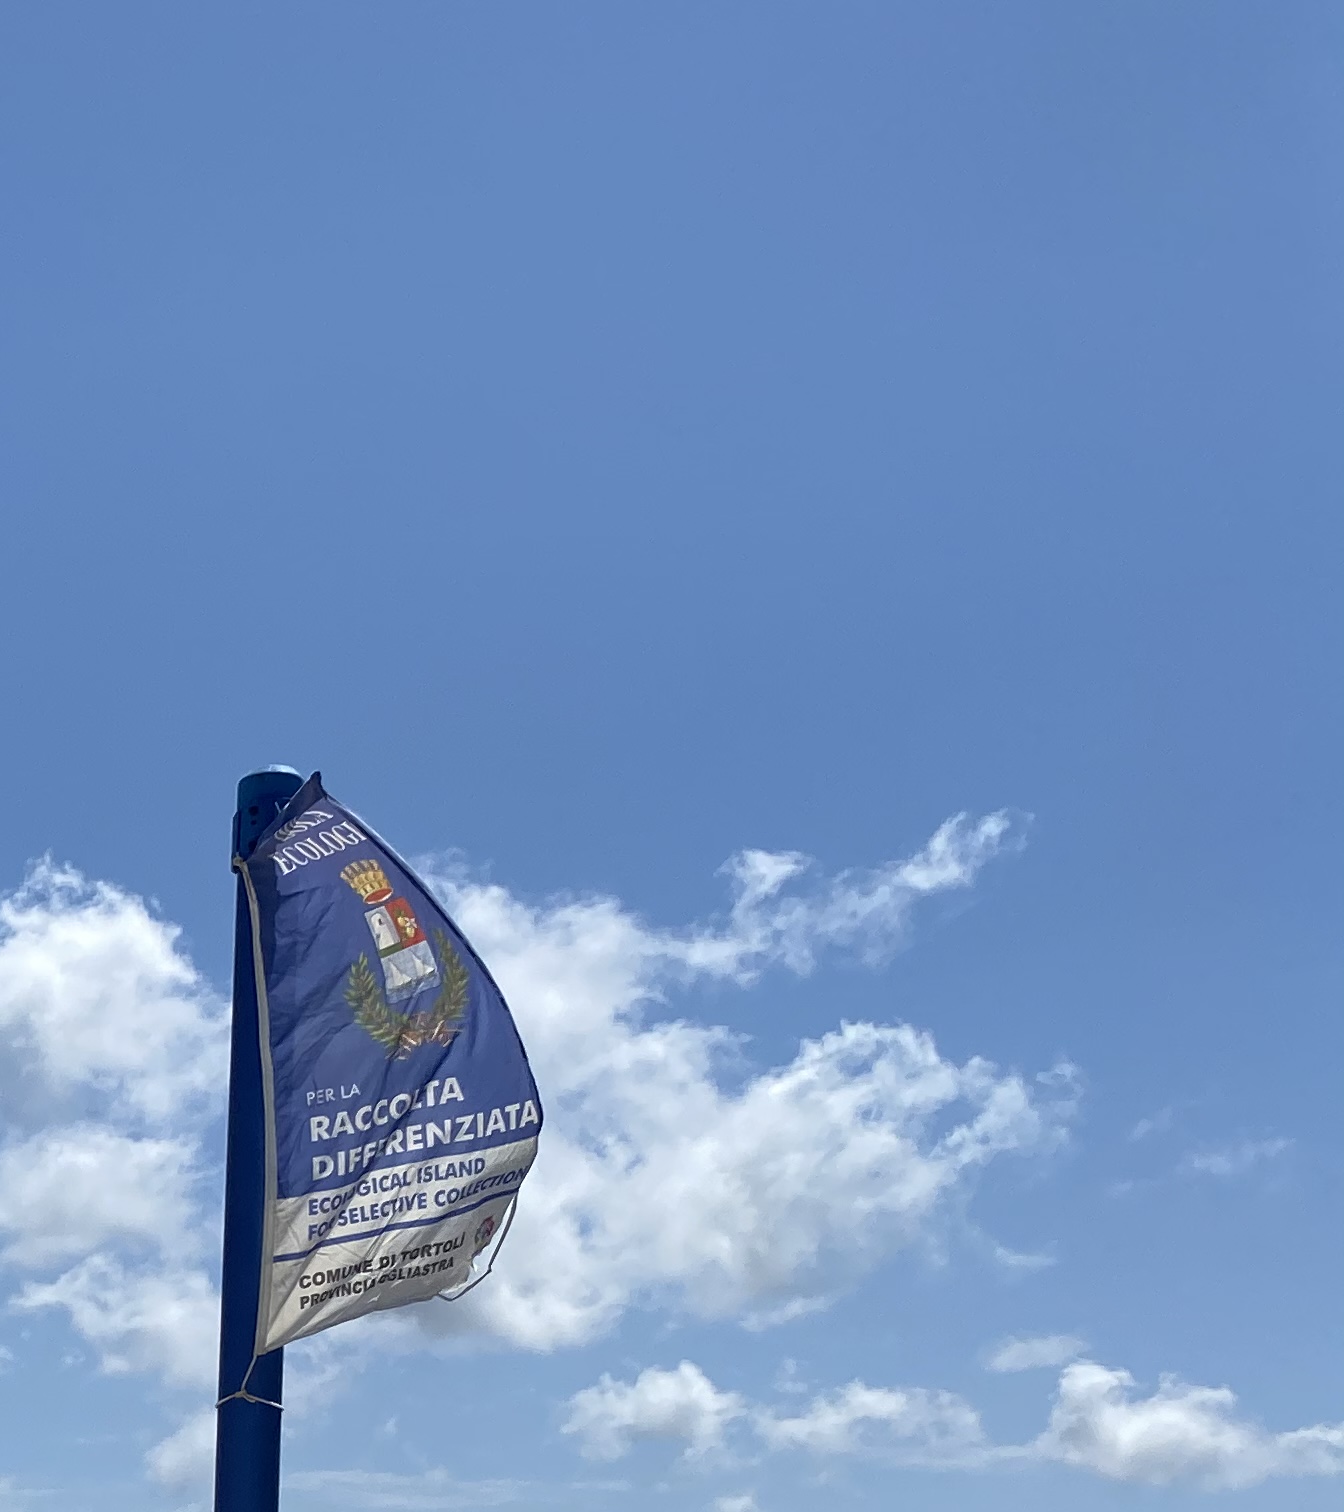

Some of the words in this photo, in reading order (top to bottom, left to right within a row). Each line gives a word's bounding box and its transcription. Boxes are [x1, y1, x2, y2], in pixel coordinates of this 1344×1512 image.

[306, 1088, 336, 1106] PER
[341, 1084, 361, 1099] LA
[417, 1158, 486, 1184] ISLAND
[338, 1192, 427, 1227] SELECTIVE
[434, 1165, 529, 1206] COLLECTION
[299, 1259, 373, 1289] COMUNE
[378, 1254, 396, 1269] DI
